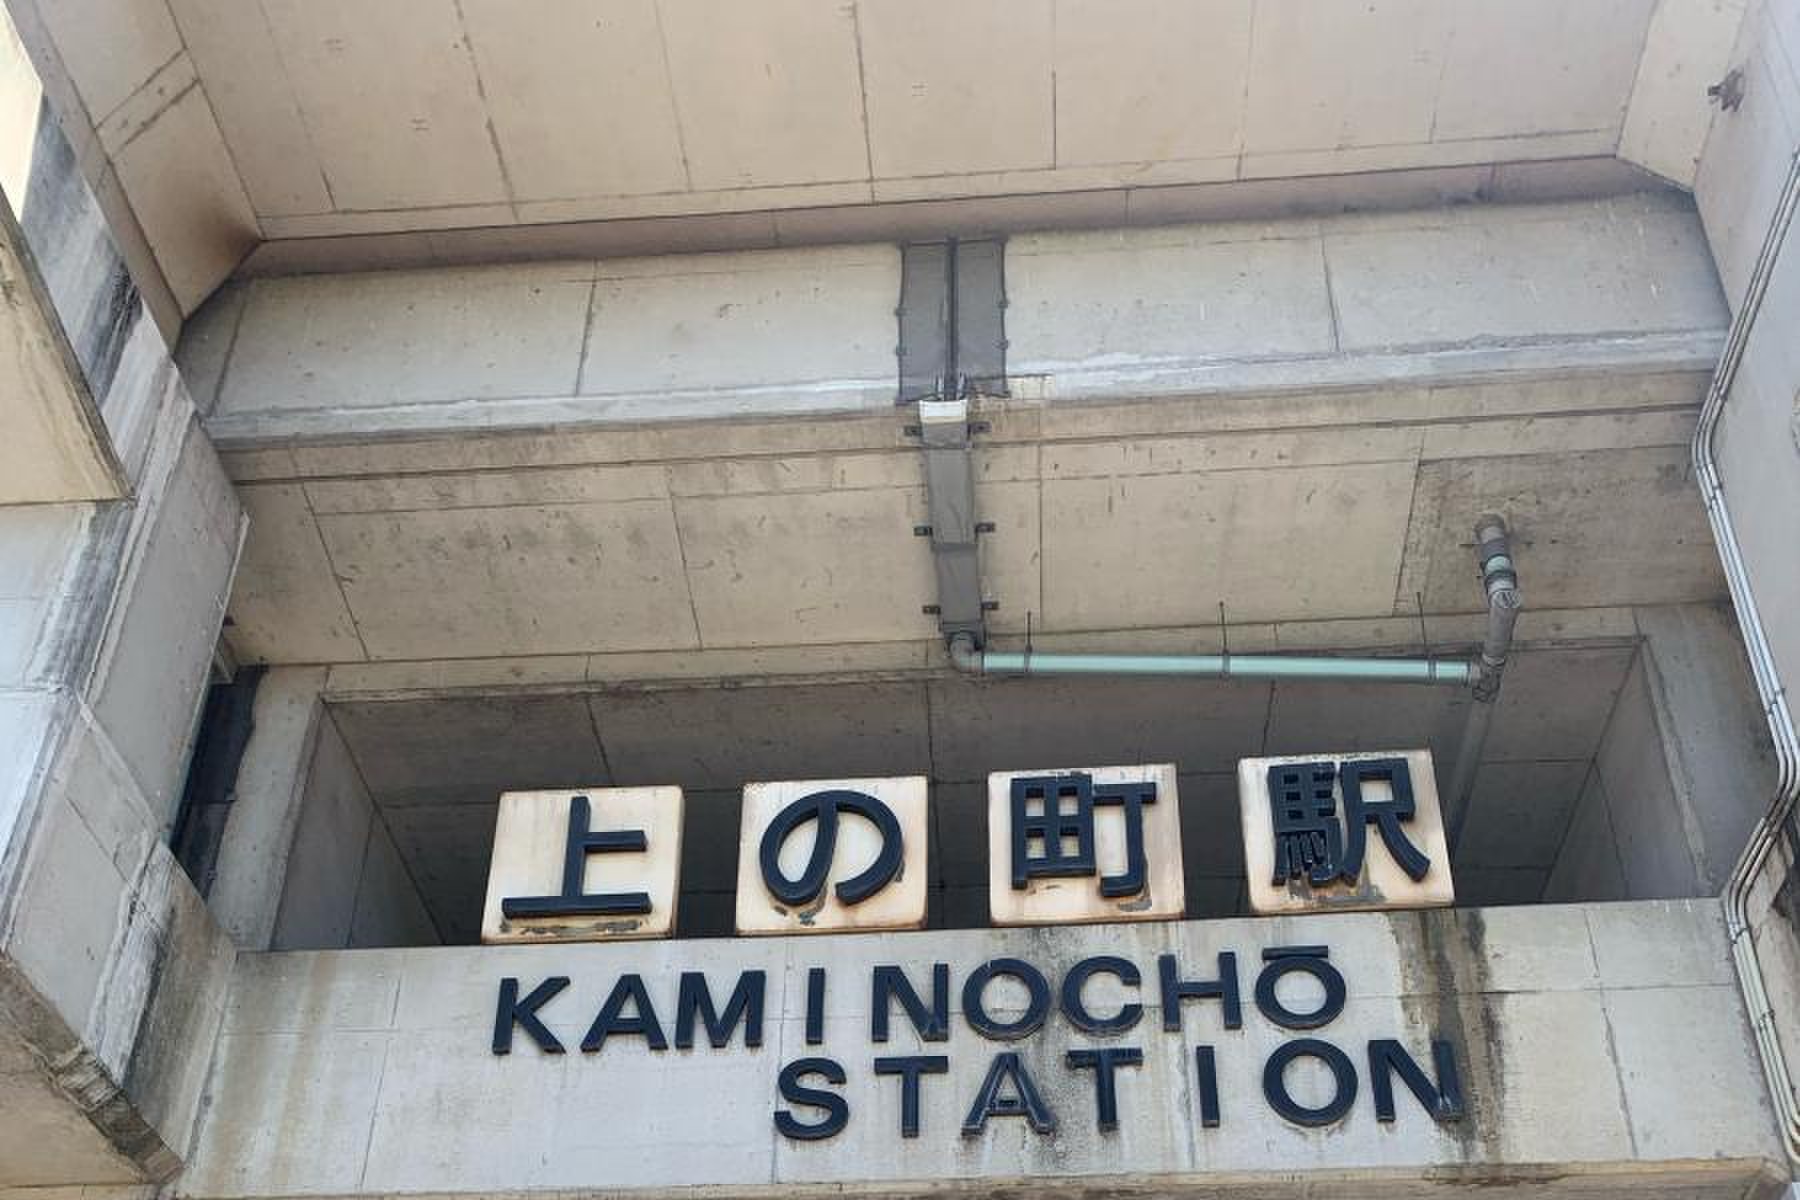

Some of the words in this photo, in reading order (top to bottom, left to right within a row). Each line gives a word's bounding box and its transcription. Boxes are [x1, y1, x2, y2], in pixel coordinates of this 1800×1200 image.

[501, 756, 1430, 920] 上の町駅
[773, 1037, 1460, 1140] STATION
